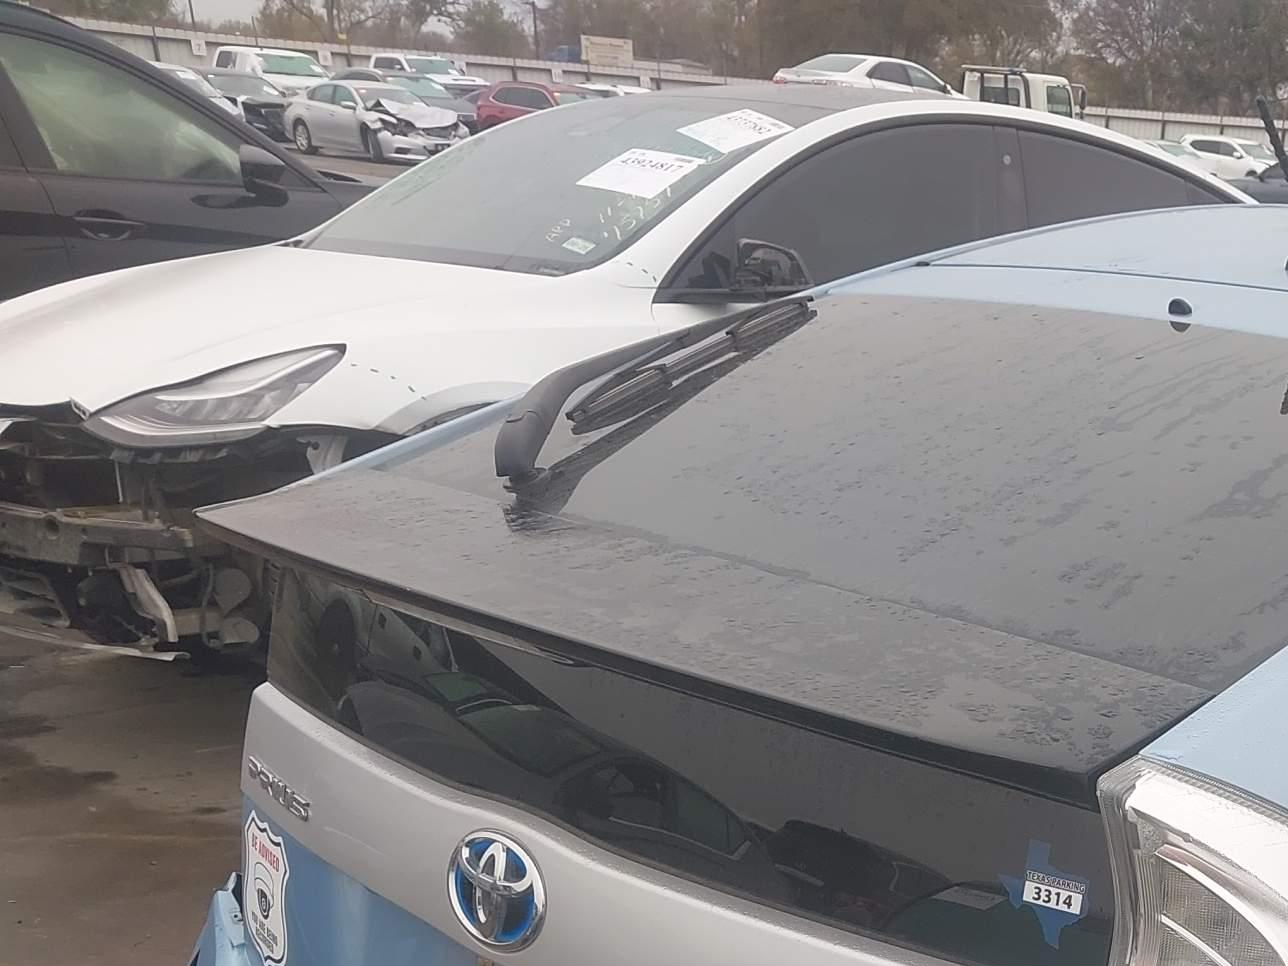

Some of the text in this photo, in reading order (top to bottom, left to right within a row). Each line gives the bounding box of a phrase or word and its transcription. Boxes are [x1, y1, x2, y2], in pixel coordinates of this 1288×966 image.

[248, 755, 312, 822] PRIUS
[251, 831, 280, 872] BE ADVISED
[1026, 870, 1086, 893] TEXAS PARKING
[1031, 886, 1073, 910] 3314
